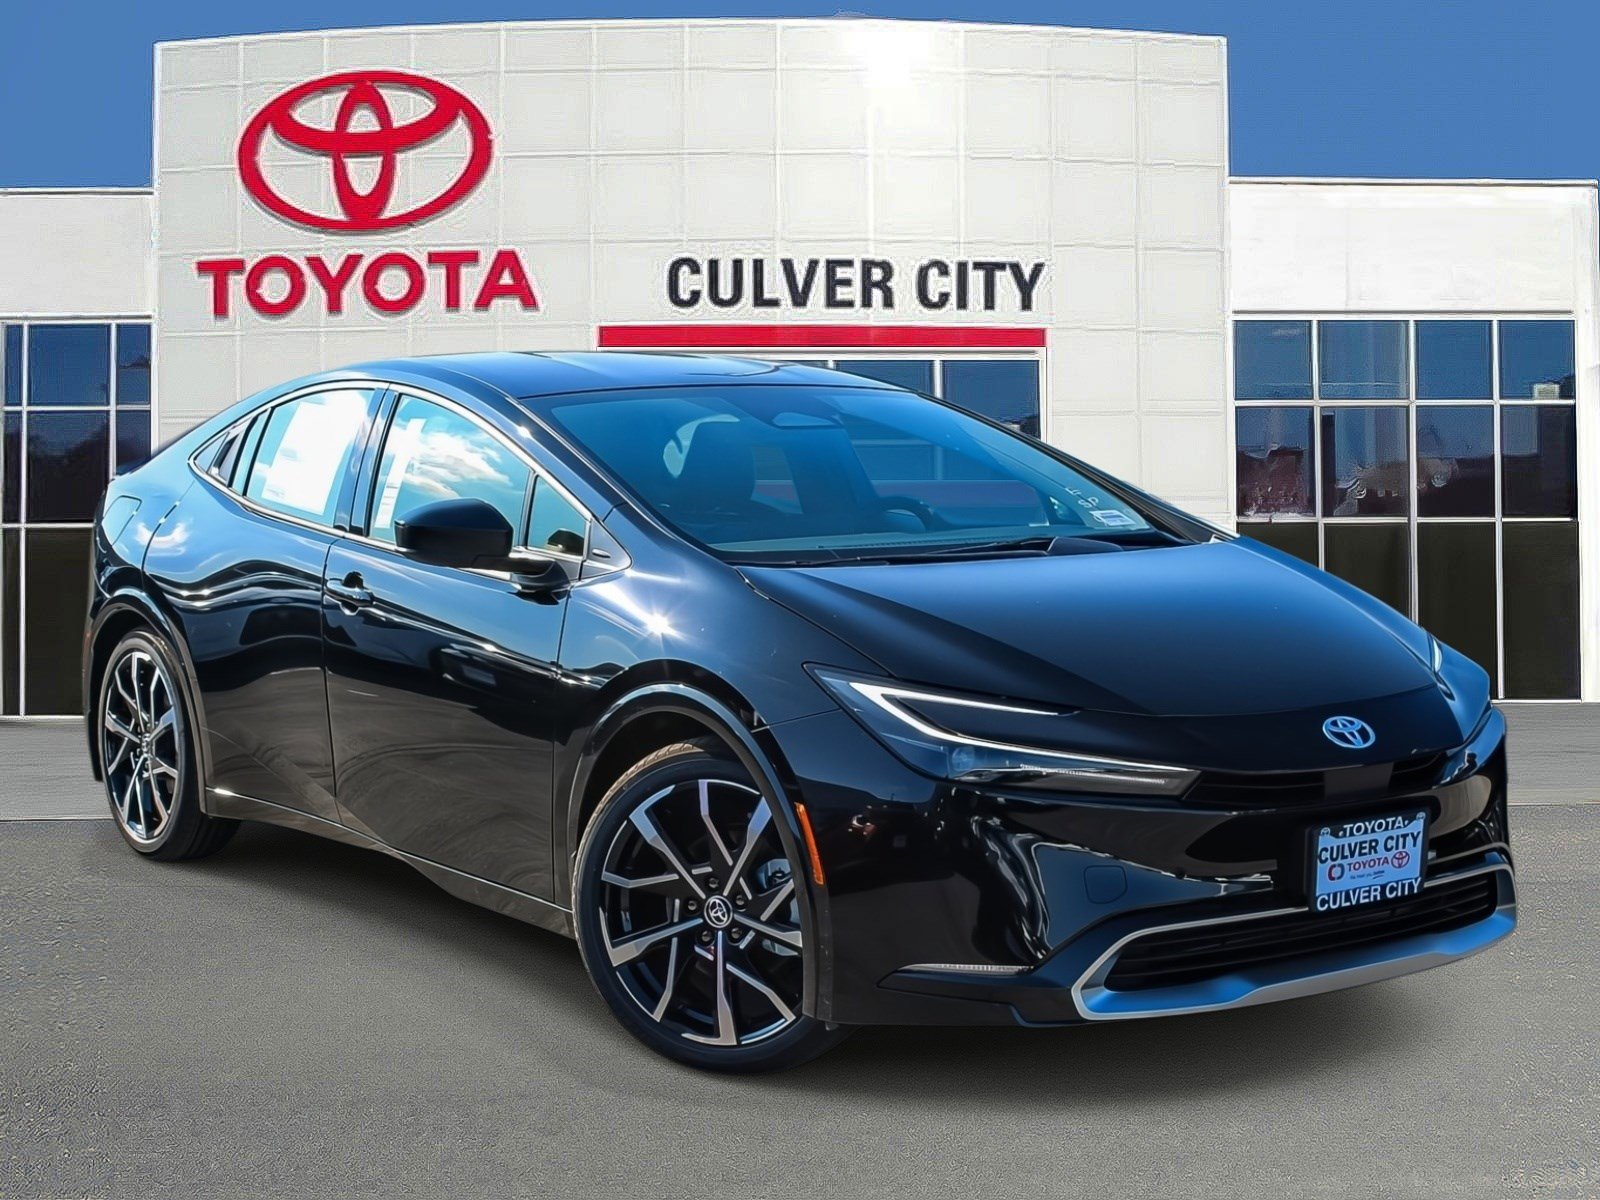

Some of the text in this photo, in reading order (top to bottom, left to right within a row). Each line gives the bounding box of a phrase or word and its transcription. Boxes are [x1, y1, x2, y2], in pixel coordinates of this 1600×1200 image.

[196, 249, 540, 318] TOYOTA
[667, 257, 1045, 311] CULVER CITY
[1343, 816, 1404, 837] TOYOTA
[1318, 831, 1421, 864] CULVER CITY
[1348, 856, 1390, 872] TOYOTA
[1316, 877, 1421, 911] CULVER CITY
